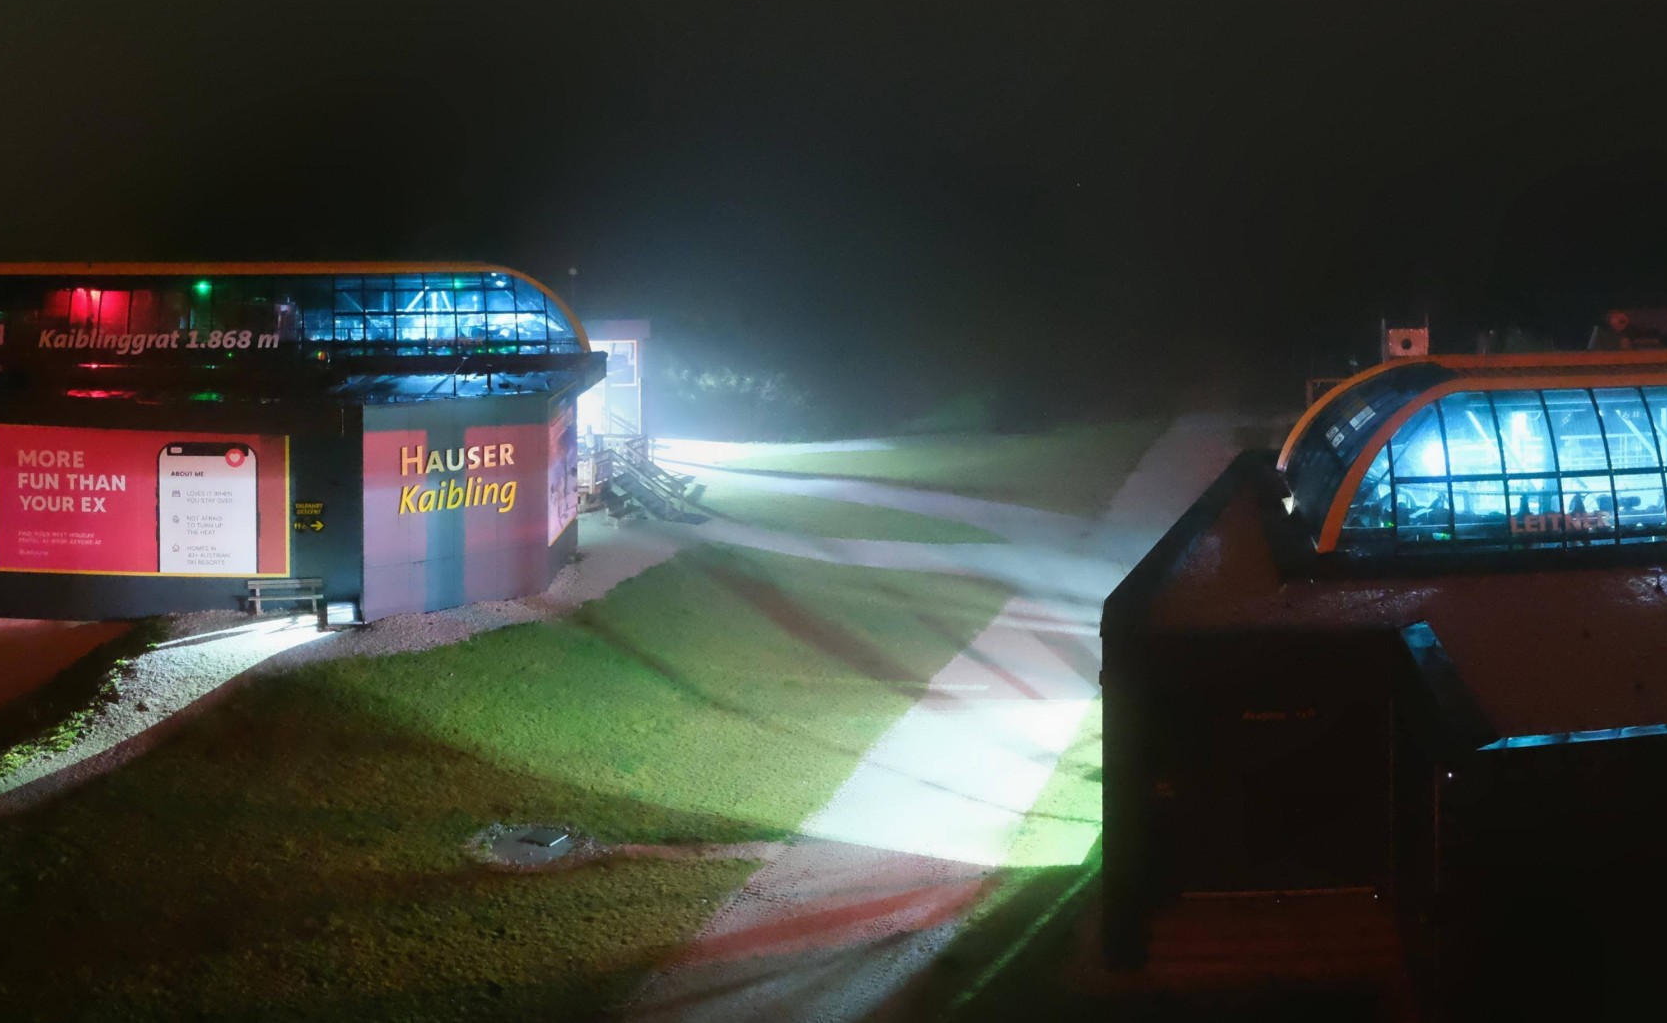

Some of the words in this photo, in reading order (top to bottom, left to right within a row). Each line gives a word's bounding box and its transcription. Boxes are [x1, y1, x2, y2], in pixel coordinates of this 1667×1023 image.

[38, 329, 179, 355] Kaiblinggrat
[185, 330, 251, 349] 1.868
[257, 334, 280, 349] m
[17, 449, 85, 468] MORE
[400, 443, 515, 476] HAUSER
[18, 472, 59, 490] FUN
[66, 474, 126, 492] THAN
[20, 495, 75, 512] YOUR
[81, 496, 107, 513] EX
[399, 477, 518, 515] Kaibling
[1510, 511, 1612, 533] LEITNER
